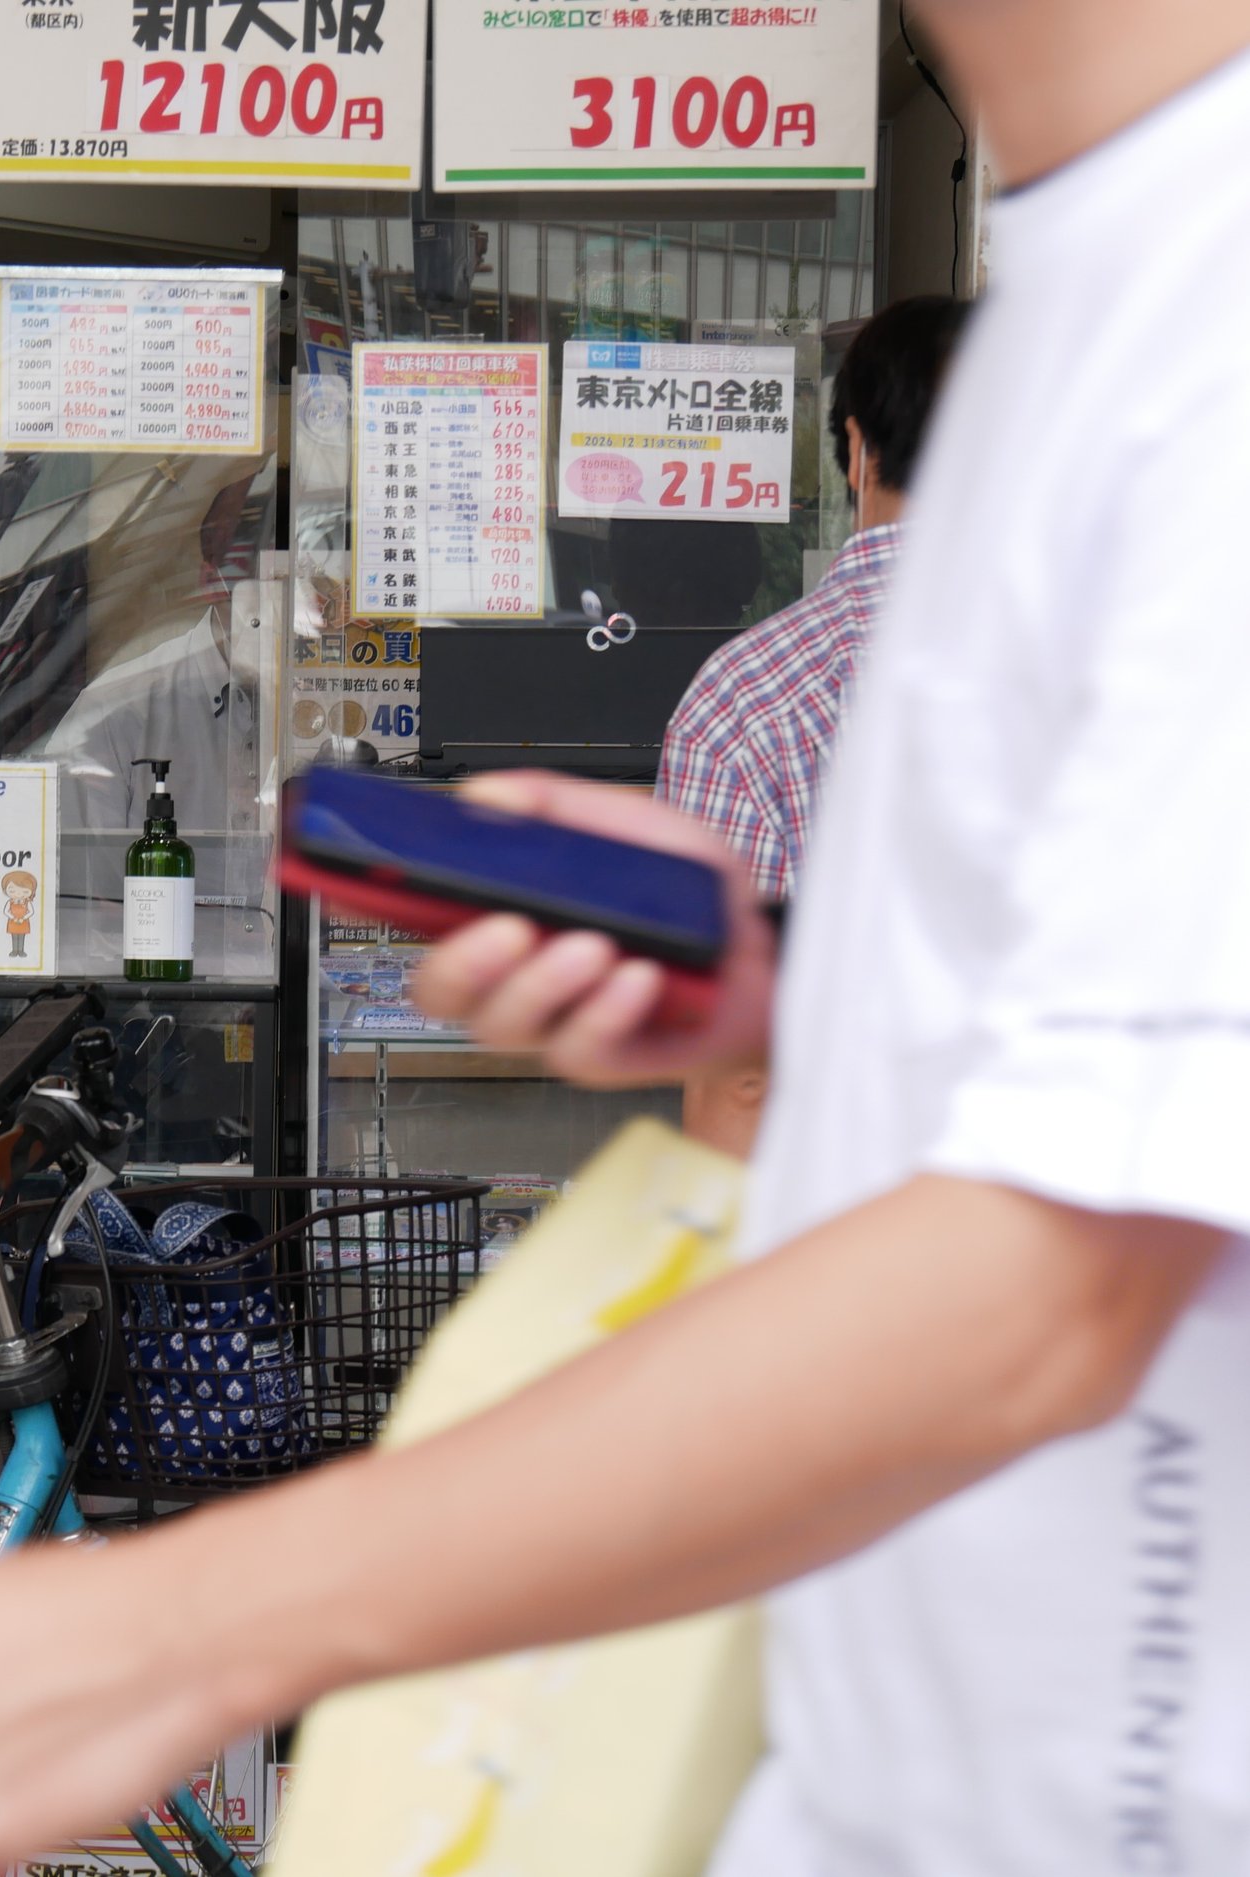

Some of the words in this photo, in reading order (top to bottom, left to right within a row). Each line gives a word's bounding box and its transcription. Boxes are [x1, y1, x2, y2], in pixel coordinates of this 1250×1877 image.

[24, 12, 84, 29] (都区内)
[133, 0, 384, 54] 新大阪
[99, 60, 384, 140] 12100円
[569, 75, 816, 149] 3100円
[383, 356, 519, 372] 私鉄株優1回乗車券
[576, 375, 783, 413] 東京メトロ全線
[381, 401, 424, 416] 小田急
[384, 421, 418, 436] 西武
[667, 412, 789, 434] 片道1回乗車券
[384, 443, 417, 457] 京王
[384, 464, 417, 478] 東急
[384, 485, 418, 499] 相鉄
[659, 461, 780, 509] 215円
[383, 506, 417, 520] 京急
[383, 526, 417, 540] 京成
[383, 548, 417, 562] 東武
[383, 573, 418, 588] 名鉄
[383, 593, 418, 608] 近鉄
[293, 631, 420, 665] 本日の買
[130, 888, 166, 898] ALCOHOL
[138, 902, 153, 911] GEL
